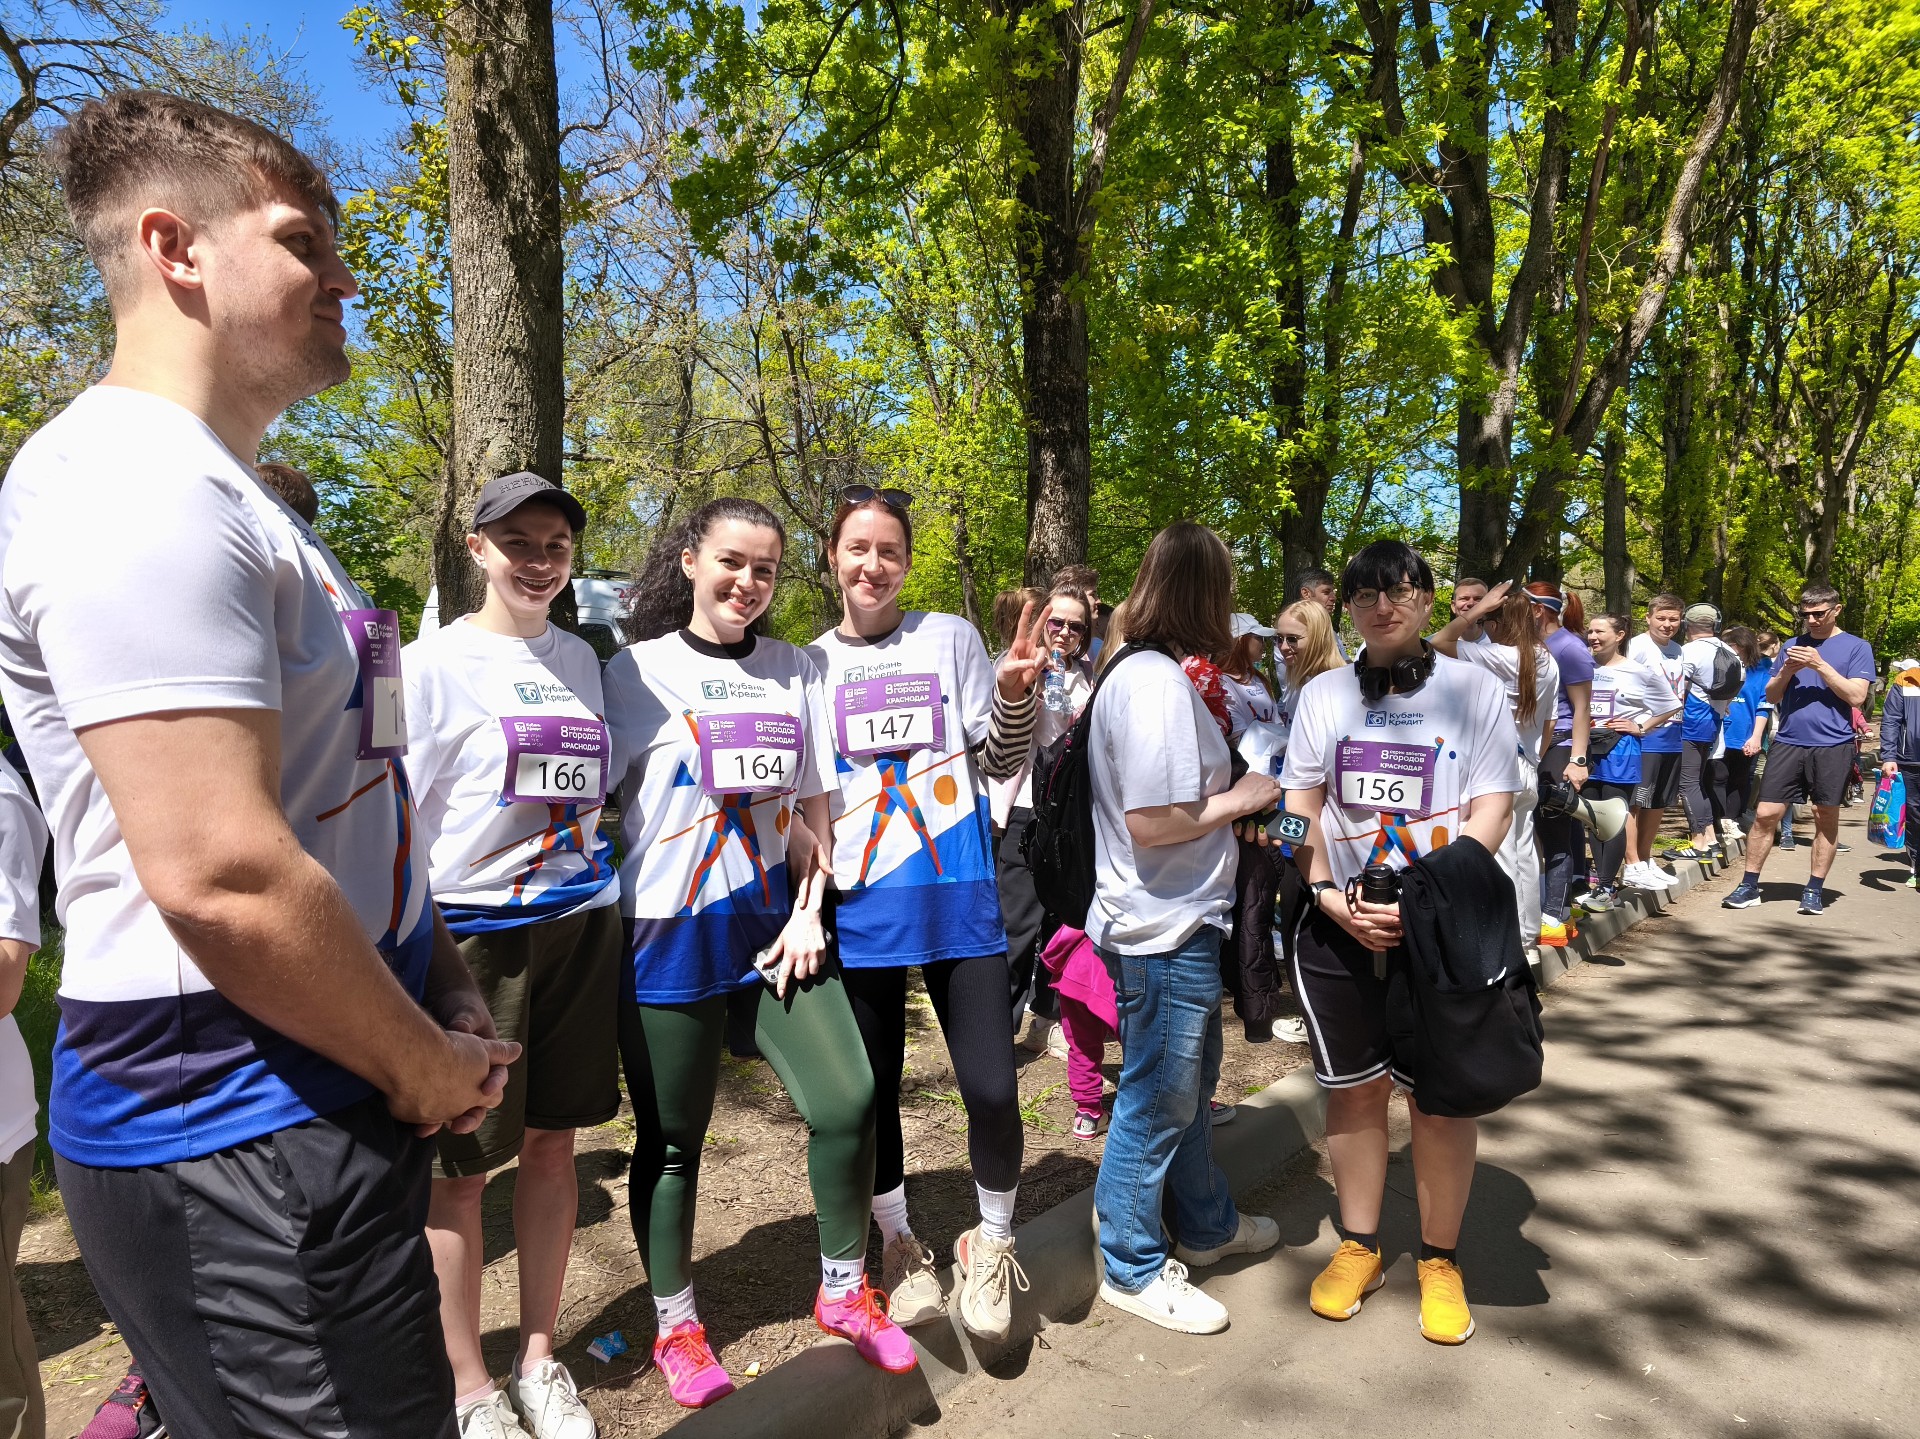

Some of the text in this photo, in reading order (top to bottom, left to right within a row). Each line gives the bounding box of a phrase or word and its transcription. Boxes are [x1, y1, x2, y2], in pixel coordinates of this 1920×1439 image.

[867, 661, 902, 673] Кубань
[540, 684, 573, 693] Кубань
[728, 681, 765, 691] Кубань
[885, 683, 930, 695] 8 городов
[543, 693, 576, 702] Кредит
[730, 690, 767, 699] Кредит
[886, 694, 930, 705] КРАСНОДАР
[1389, 712, 1424, 720] Кубань
[755, 720, 796, 735] 8 городов
[865, 713, 914, 743] 147
[1388, 719, 1424, 727] Кредит
[560, 725, 601, 742] 8 городов
[756, 735, 796, 745] КРАСНОДАР
[561, 741, 601, 752] КРАСНОДАР
[1380, 749, 1425, 764] 8 городов
[734, 754, 785, 781] 164
[1379, 762, 1423, 772] КРАСНОДАР
[538, 761, 586, 792] 166
[1356, 777, 1405, 803] 156
